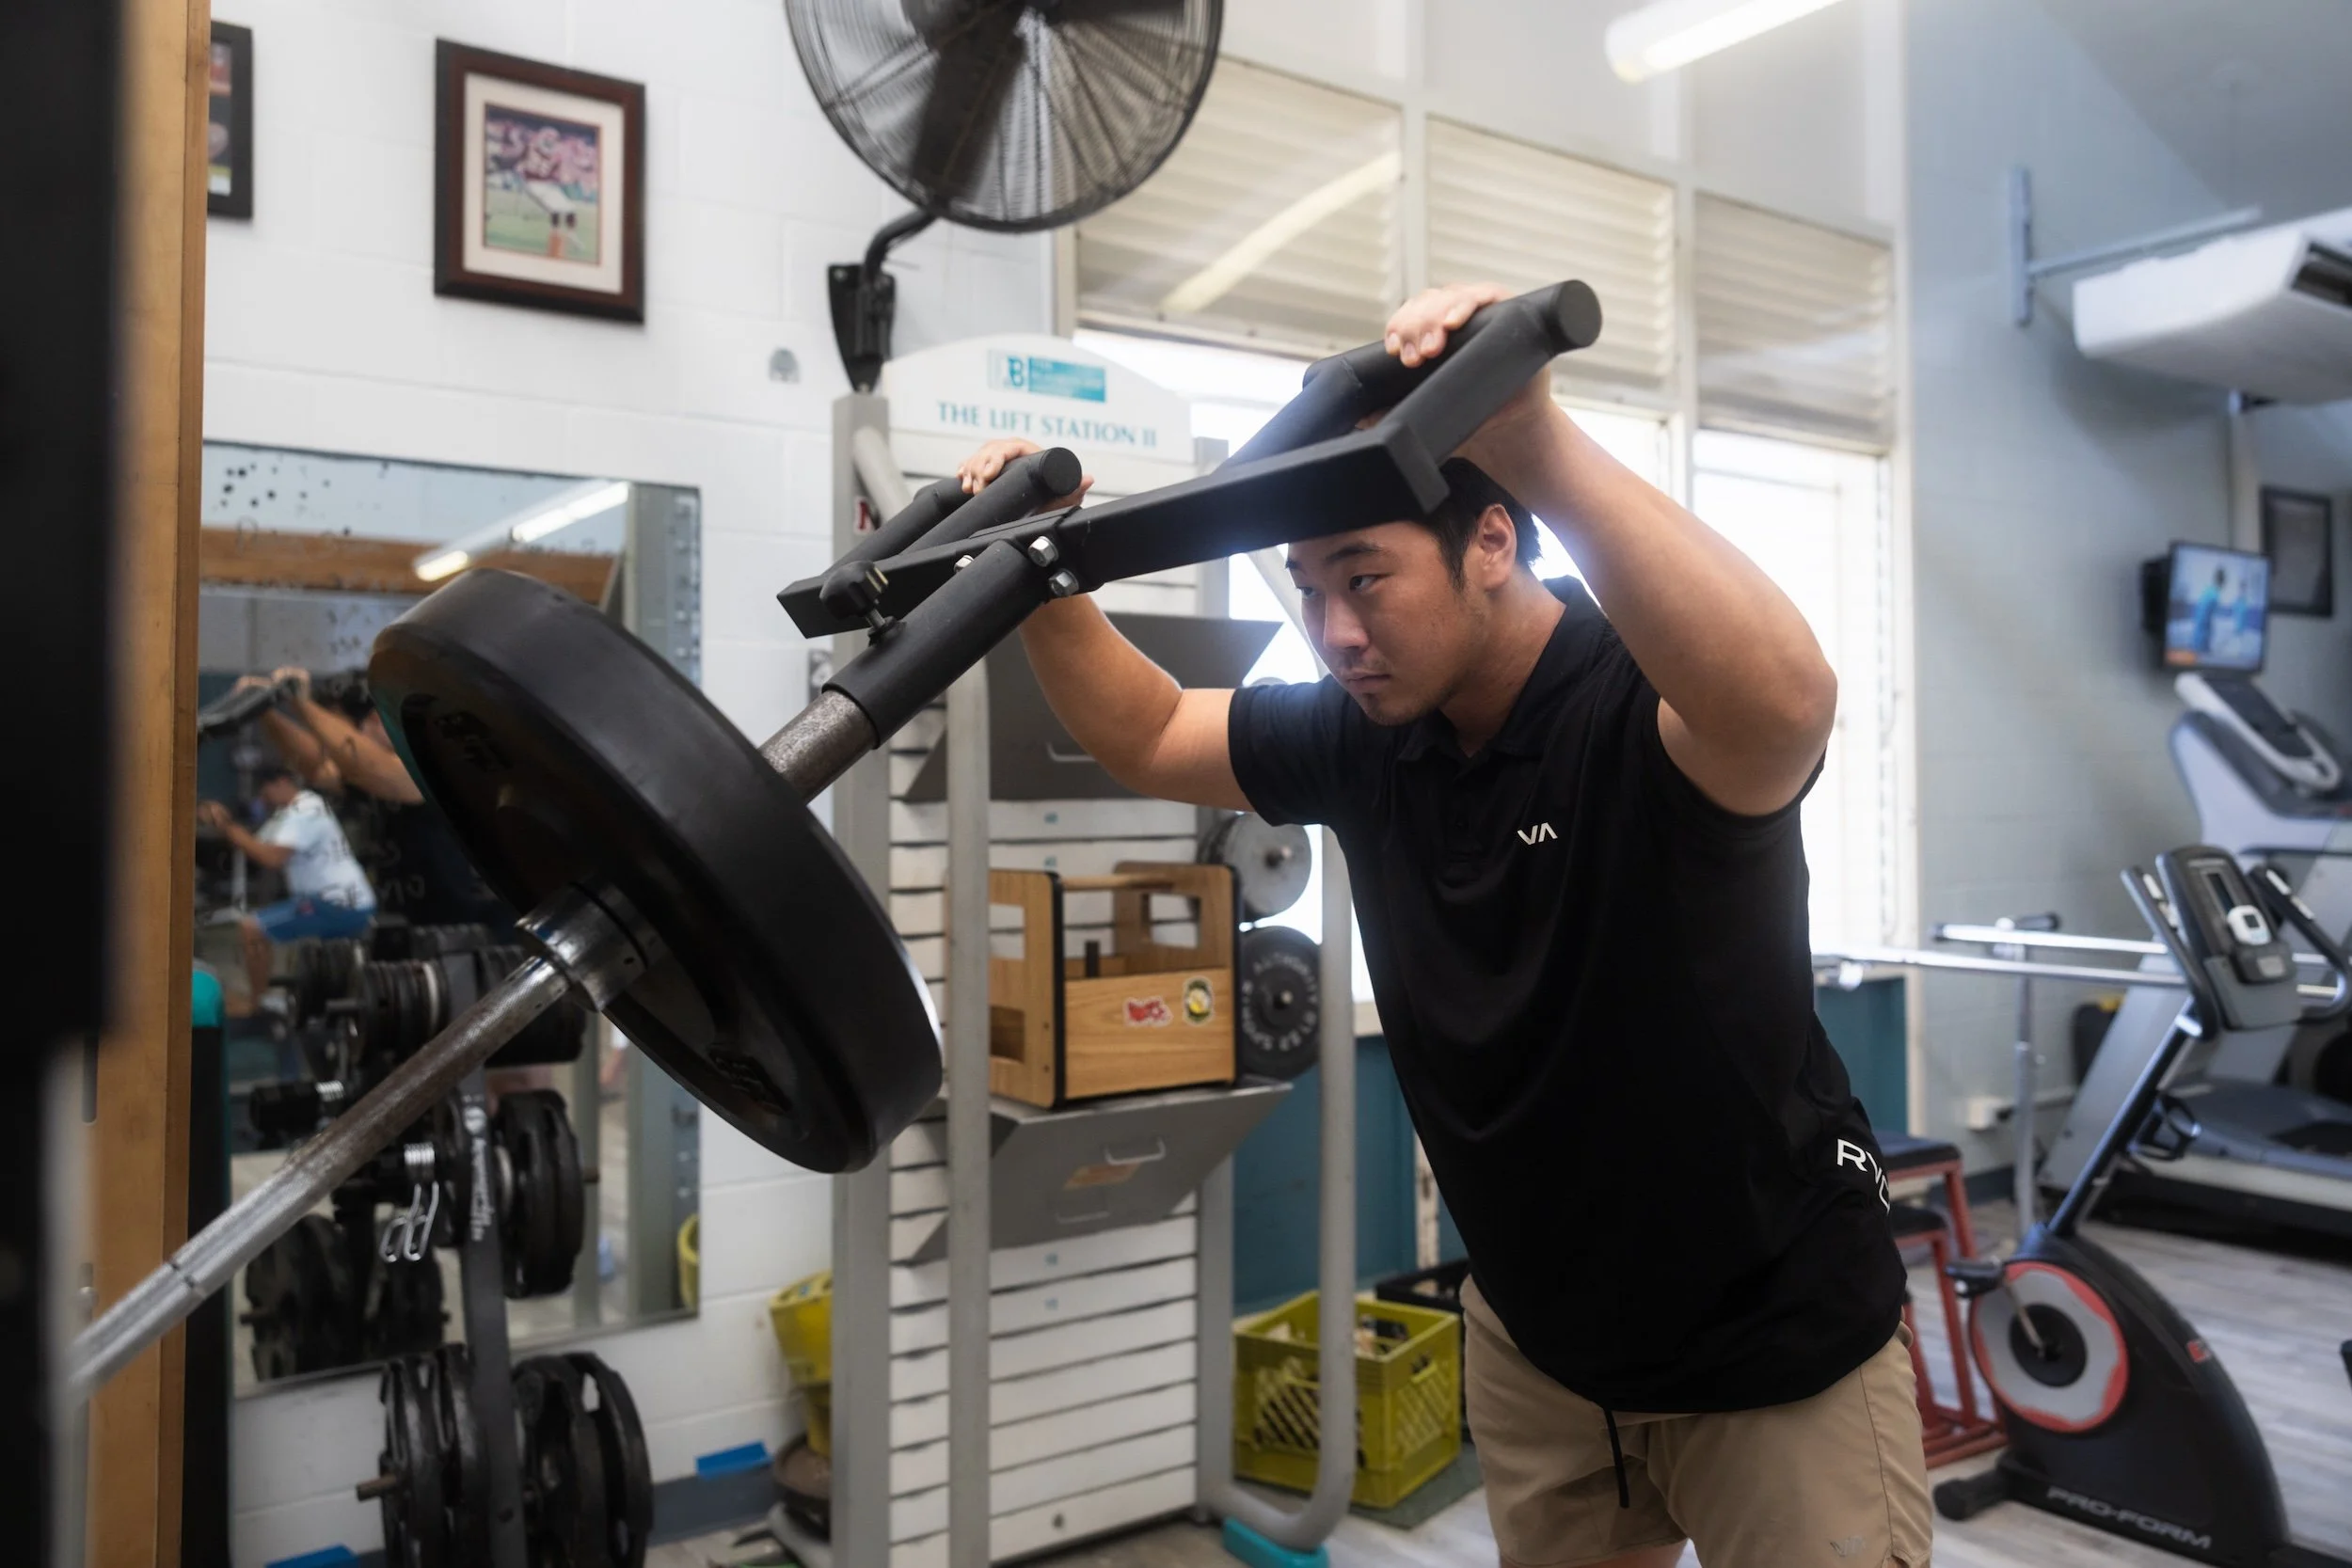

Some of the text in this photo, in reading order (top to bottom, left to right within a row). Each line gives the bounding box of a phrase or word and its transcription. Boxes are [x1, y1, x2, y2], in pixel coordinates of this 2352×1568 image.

[938, 402, 1158, 448] THE LIFT STATION II
[2045, 1485, 2213, 1549] PRO-FORM
